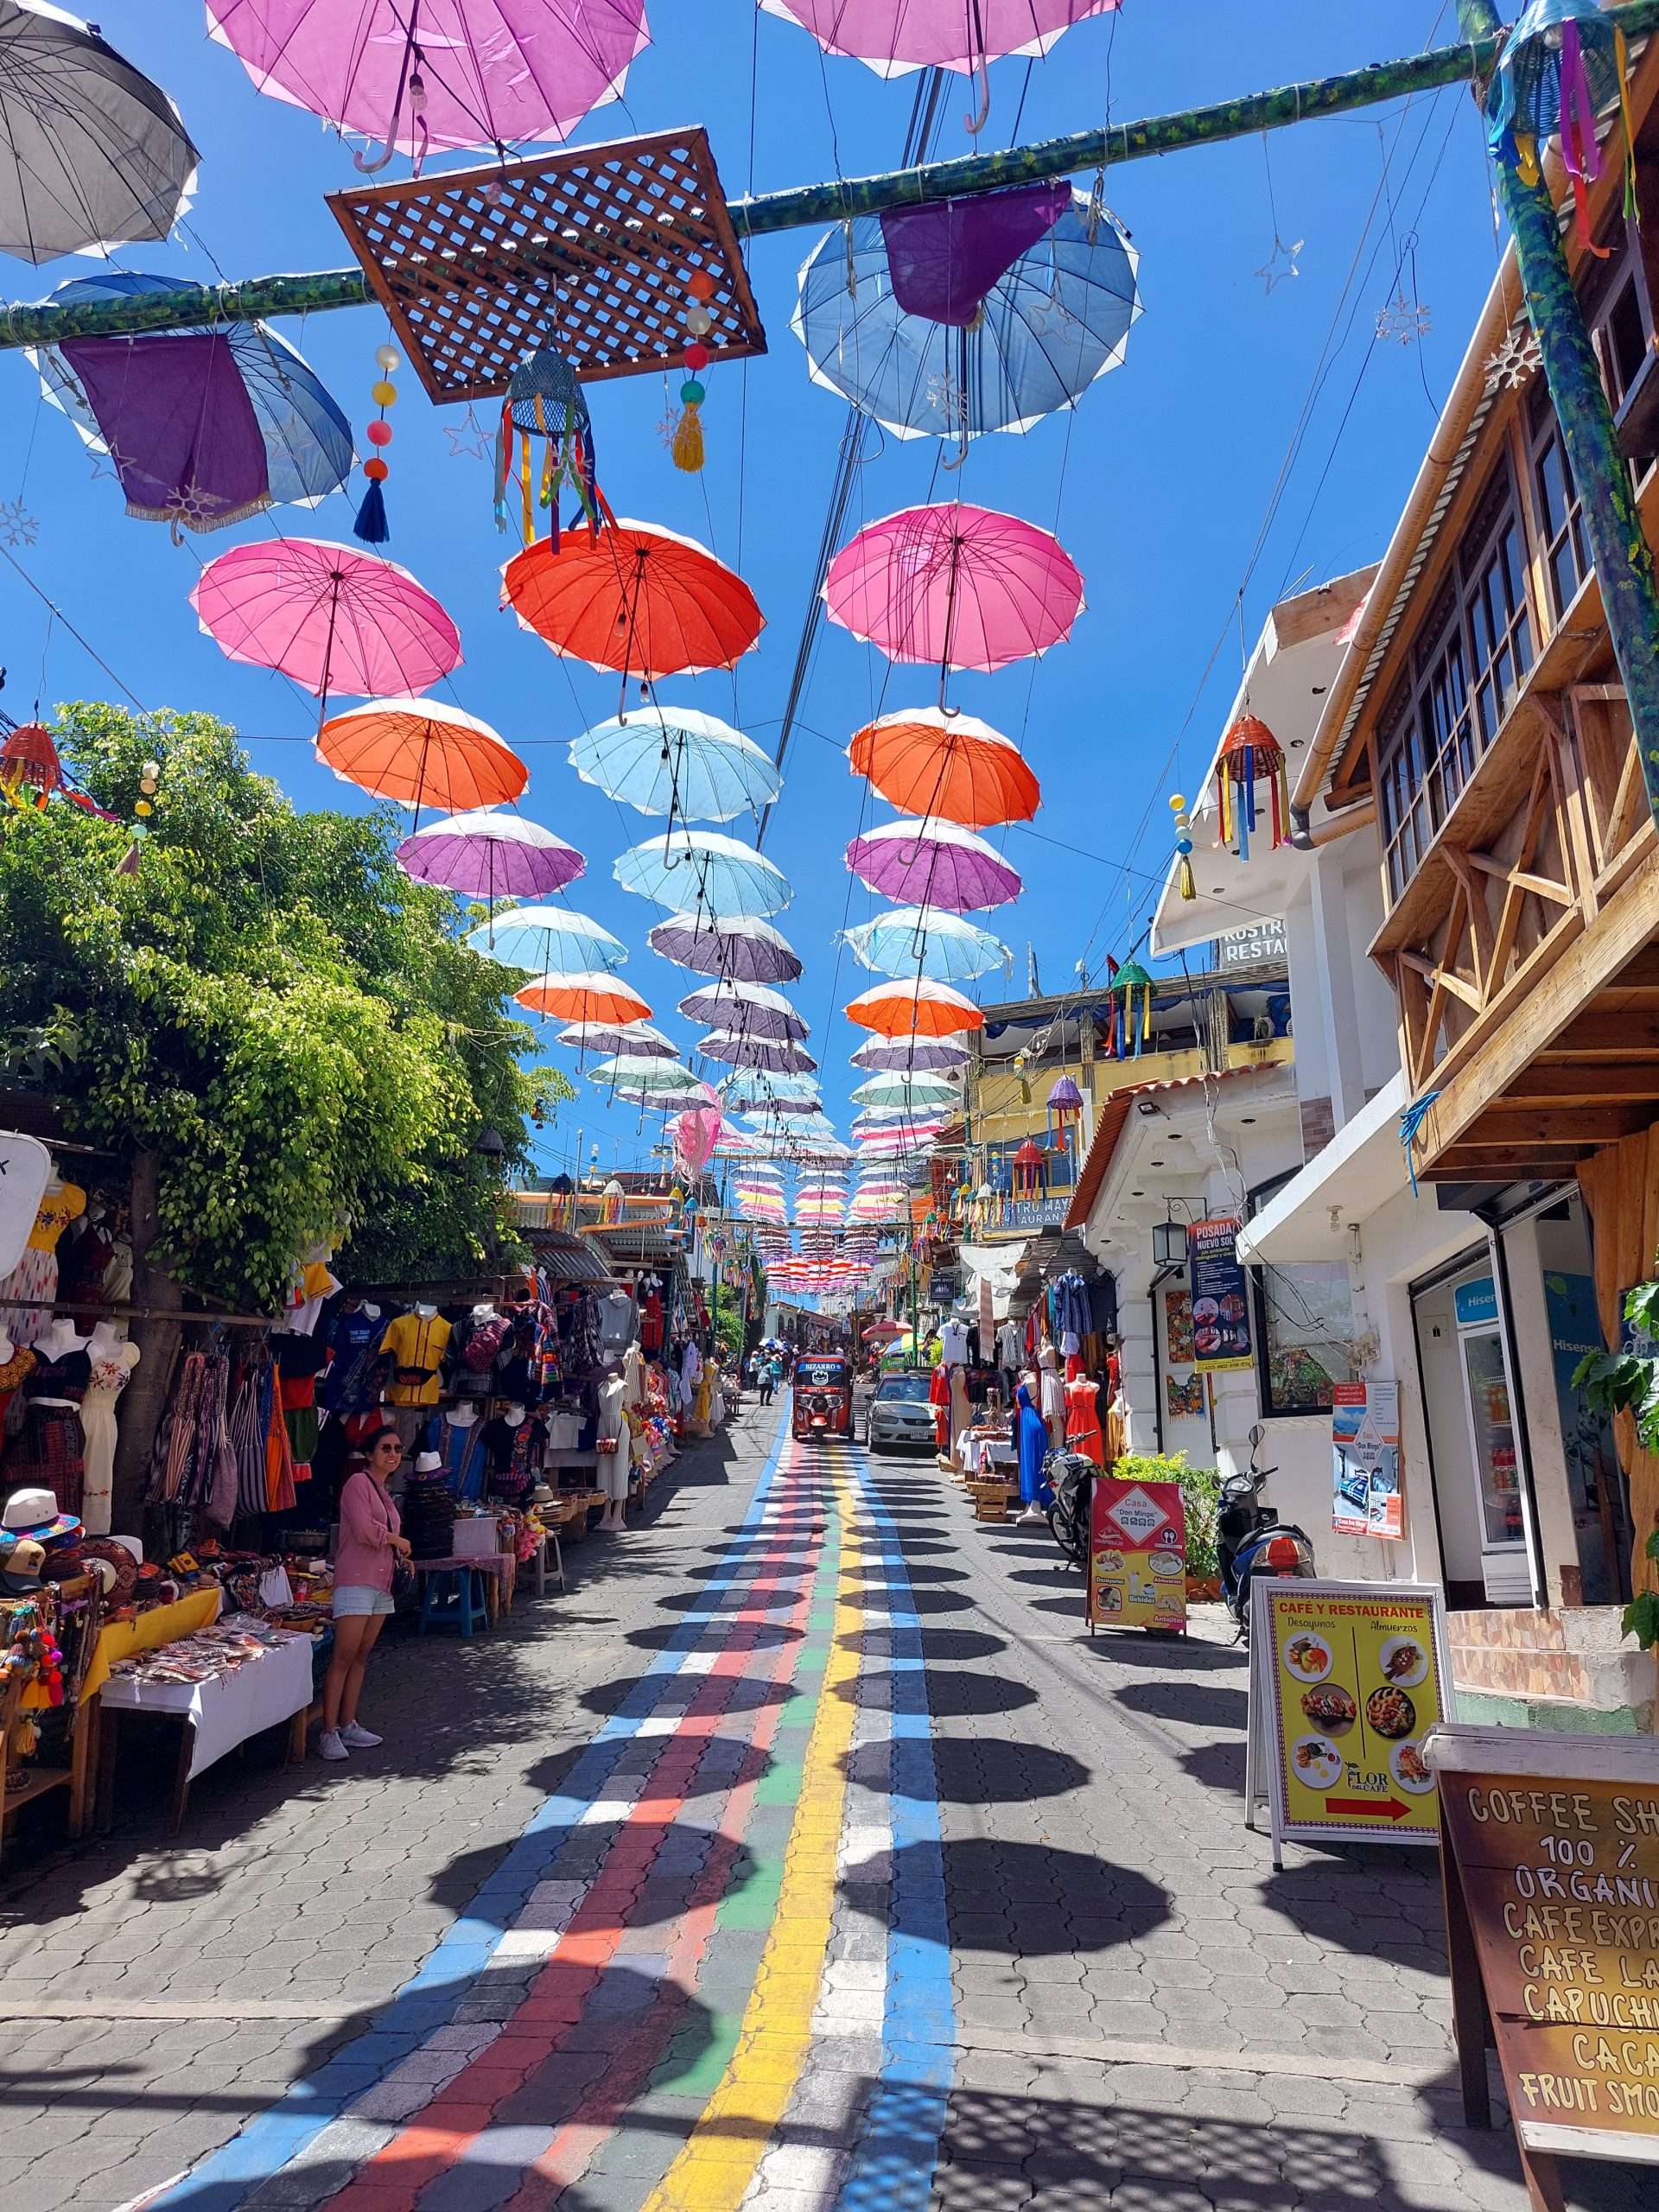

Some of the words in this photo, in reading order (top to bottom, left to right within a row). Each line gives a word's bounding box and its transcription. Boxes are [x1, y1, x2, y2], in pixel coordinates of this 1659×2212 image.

[1227, 938, 1287, 962] RESTA
[1196, 1222, 1232, 1240] POSADA
[1197, 1237, 1219, 1251] NUEVO
[1220, 1236, 1234, 1246] SOL
[1554, 1339, 1602, 1353] Hisense
[1125, 1498, 1147, 1508] Casa
[1279, 1600, 1313, 1614] CAFÉ
[1317, 1605, 1325, 1614] Y
[1329, 1605, 1424, 1618] RESTAURANTE
[1287, 1616, 1336, 1630] Desayunos
[1370, 1620, 1418, 1633] Almuerzos
[1348, 1771, 1389, 1788] FLOR
[1468, 1788, 1599, 1831] COFFEE
[1612, 1796, 1659, 1834] SH
[1539, 1835, 1595, 1866] 100
[1618, 1839, 1637, 1869] %
[1515, 1864, 1656, 1909] ORGANI
[1503, 1902, 1587, 1944] CAFE
[1590, 1910, 1659, 1949] EXPR
[1519, 1944, 1604, 1984] CAFE
[1619, 1955, 1659, 1989] LA
[1573, 2033, 1659, 2078] CACA
[1519, 2073, 1599, 2112] FRUIT
[1606, 2079, 1659, 2119] SMO
